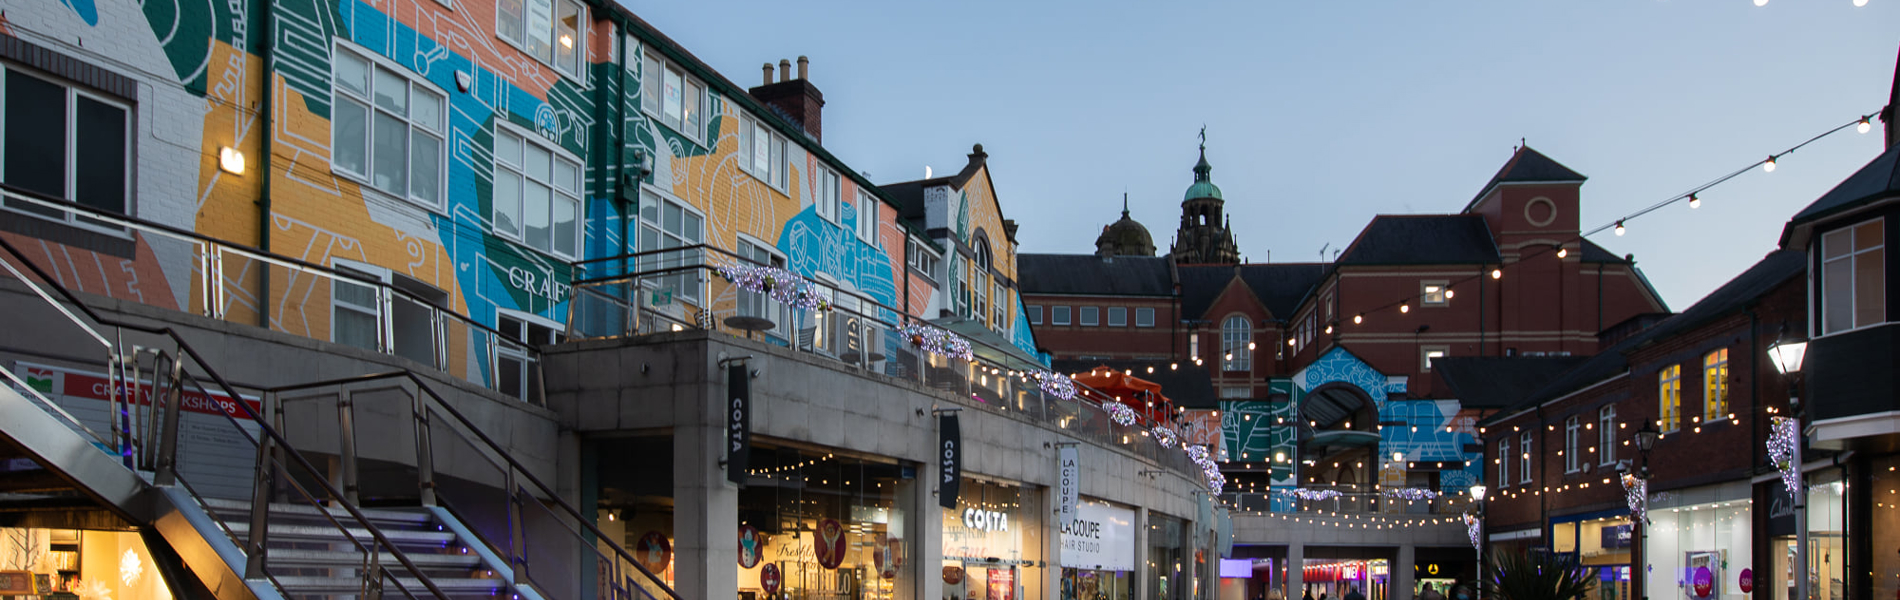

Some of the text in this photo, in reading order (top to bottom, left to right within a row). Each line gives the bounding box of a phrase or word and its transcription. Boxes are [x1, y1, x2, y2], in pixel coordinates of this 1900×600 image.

[145, 390, 236, 414] WOKSHOPS
[732, 398, 742, 452] COSTA
[943, 440, 954, 483] COSTA
[1063, 459, 1075, 468] LA
[1062, 469, 1070, 514] COUPE
[1769, 497, 1796, 519] Clark
[965, 507, 1008, 533] COSTA
[1073, 519, 1100, 539] COUPE
[1061, 539, 1100, 554] HAIR STUDIO
[809, 572, 851, 595] HELLO
